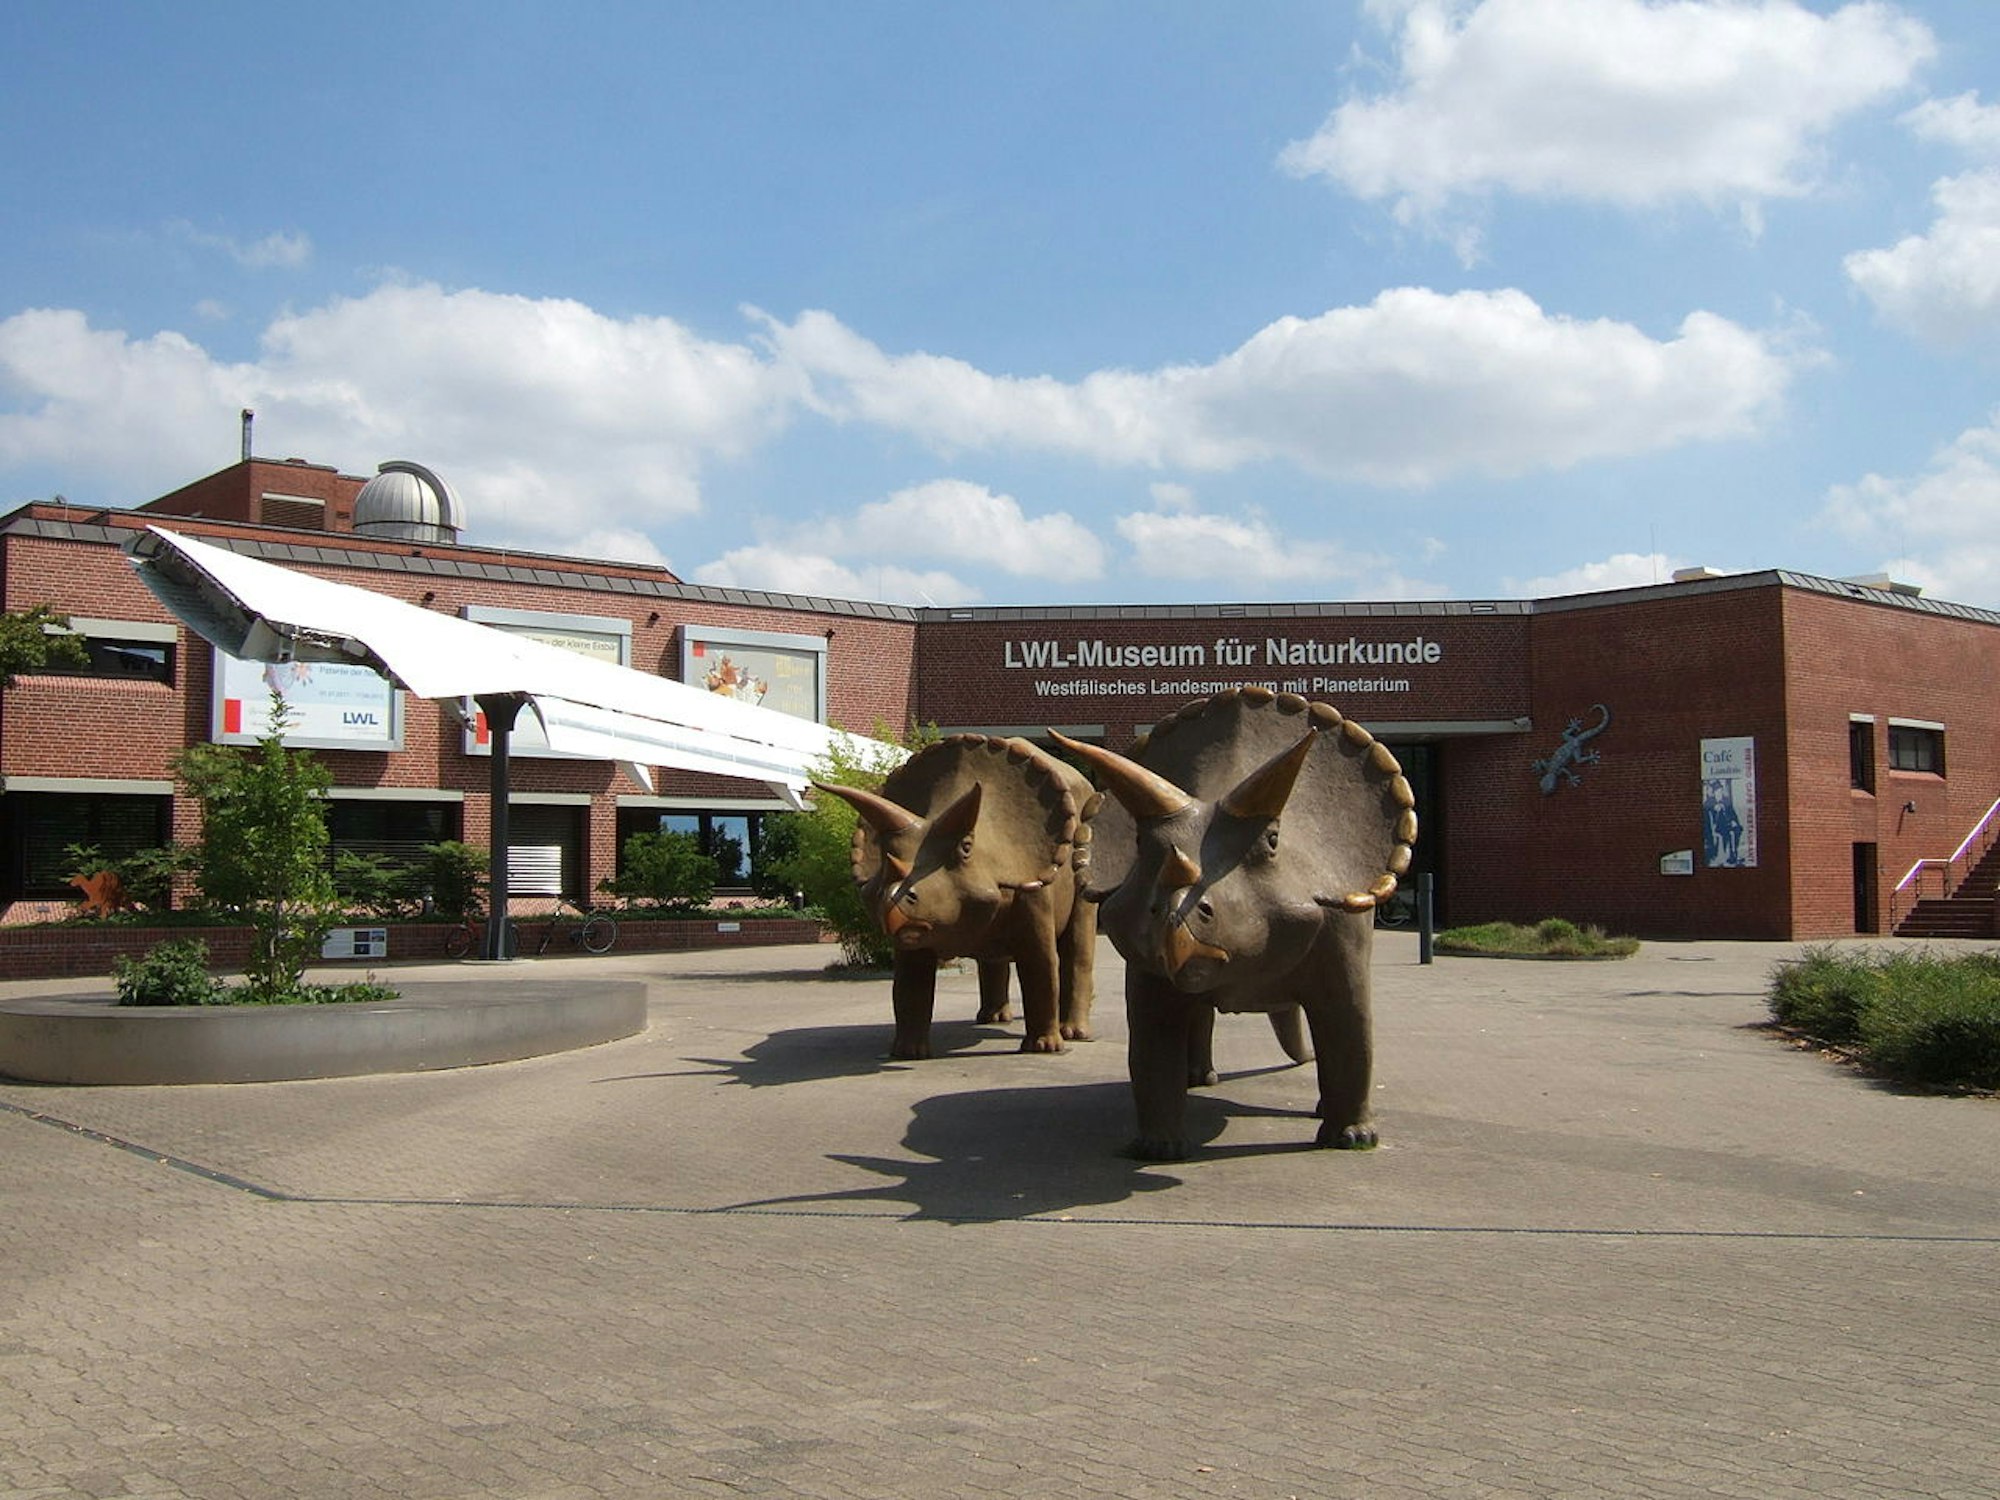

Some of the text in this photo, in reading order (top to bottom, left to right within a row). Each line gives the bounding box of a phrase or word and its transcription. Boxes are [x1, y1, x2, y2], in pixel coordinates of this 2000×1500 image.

[1004, 636, 1442, 669] LWL-Museum für Naturkunde
[1034, 680, 1147, 697] Westfälisches
[1283, 676, 1309, 694] mit
[1313, 676, 1410, 693] Planetarium
[343, 712, 379, 725] LWL
[1703, 749, 1732, 763] Café
